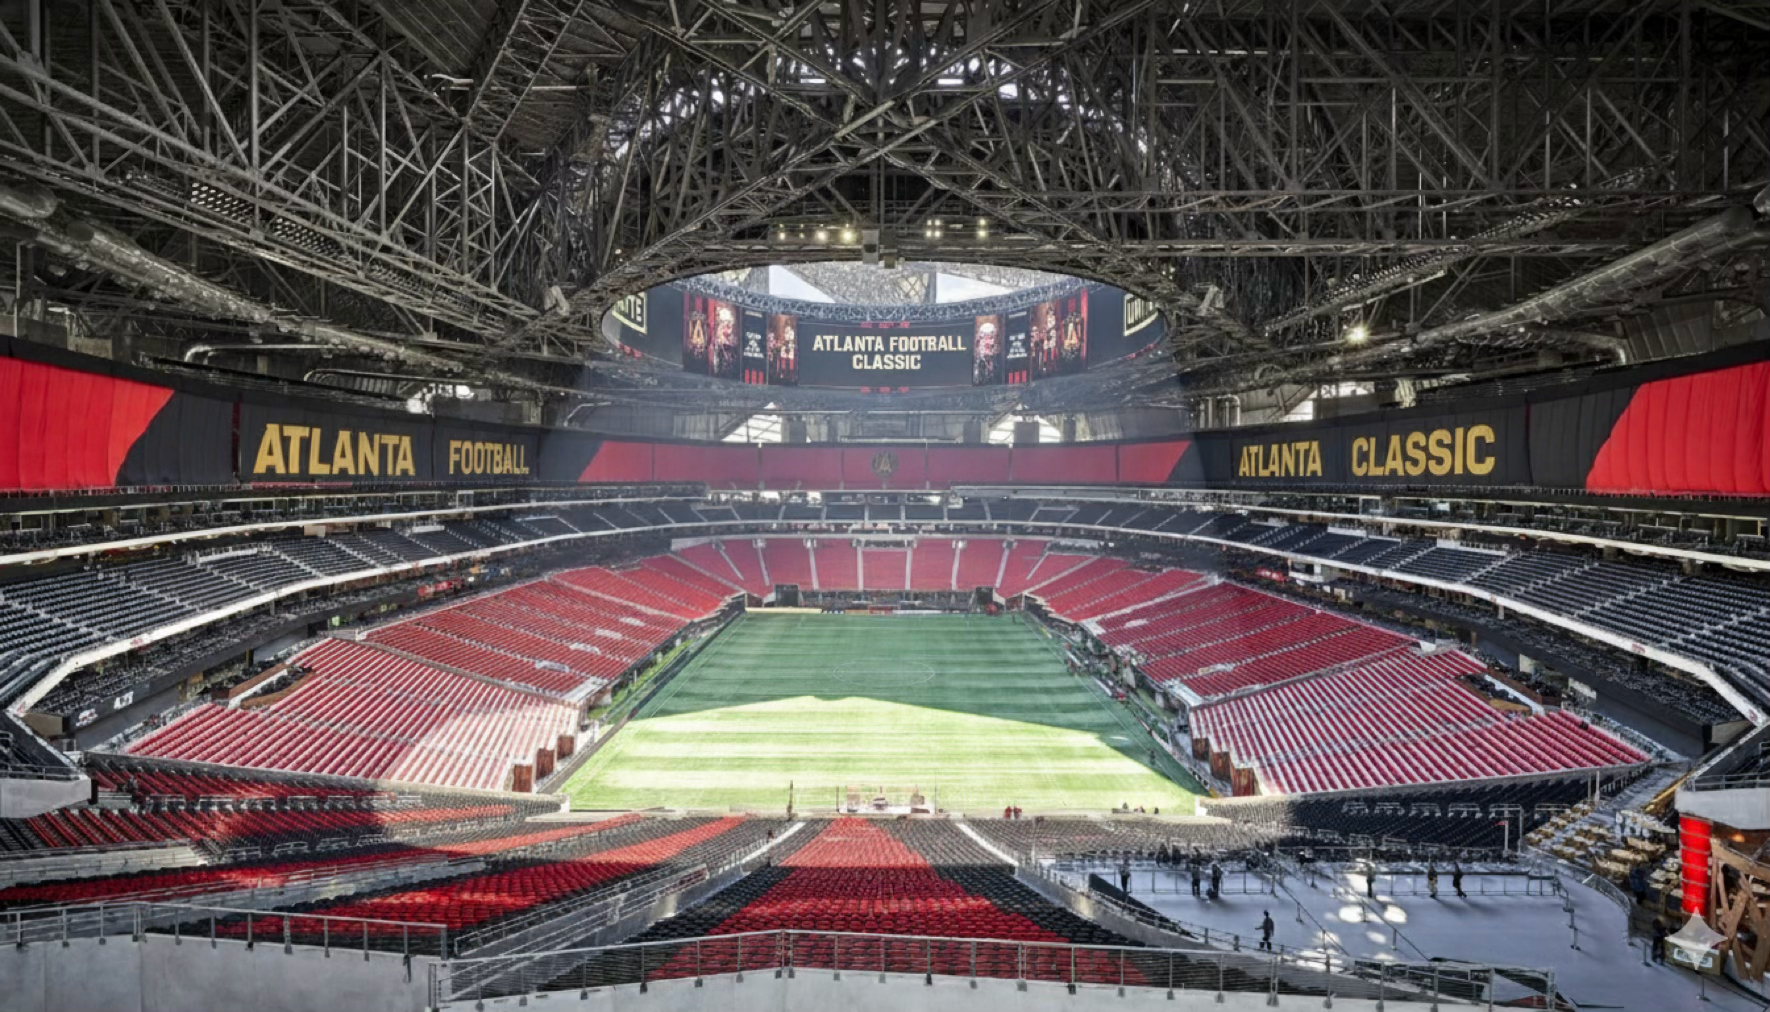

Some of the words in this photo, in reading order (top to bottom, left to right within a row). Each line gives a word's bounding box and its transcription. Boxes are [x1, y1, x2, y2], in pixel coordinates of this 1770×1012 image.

[812, 335, 885, 352] ATLANTA
[889, 335, 968, 352] FOOTBALL
[852, 354, 922, 370] CLASSIC
[253, 423, 416, 476] ATLANTA
[448, 440, 530, 475] FOOTBALL
[1238, 440, 1323, 477] ATLANTA
[1351, 423, 1496, 476] CLASSIC
